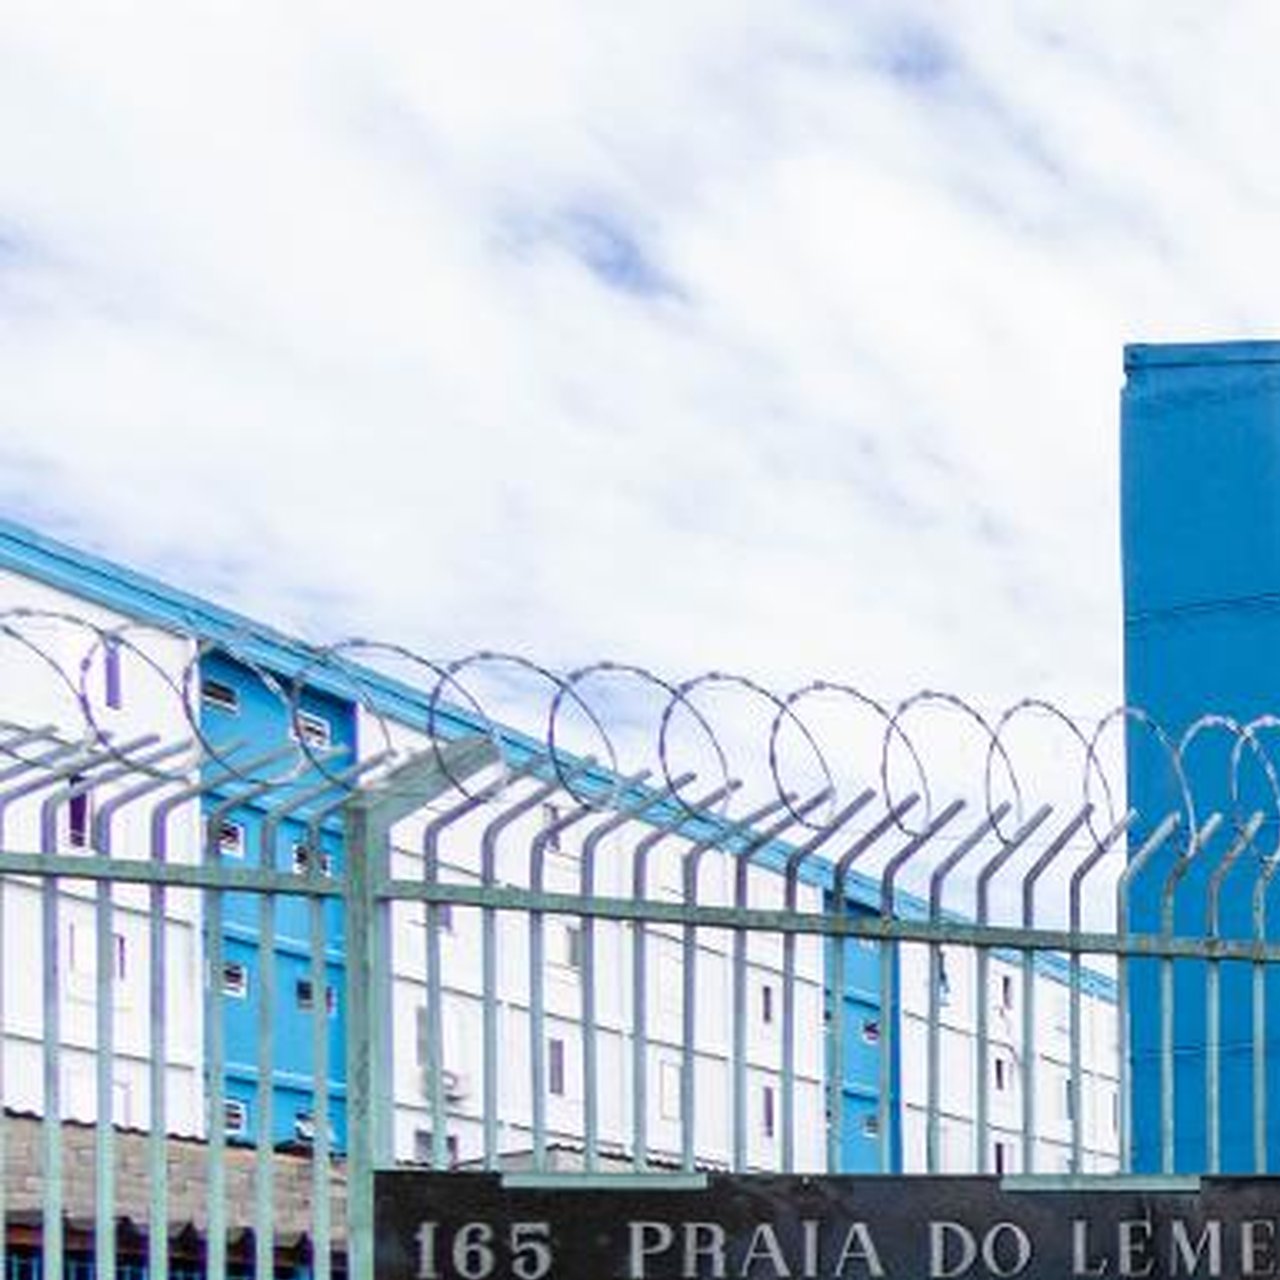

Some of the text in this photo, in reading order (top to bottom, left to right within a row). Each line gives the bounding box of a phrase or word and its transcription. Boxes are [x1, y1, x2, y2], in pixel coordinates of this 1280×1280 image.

[627, 1220, 886, 1280] PRAIA
[928, 1220, 1034, 1280] DO
[1070, 1218, 1279, 1278] LEME
